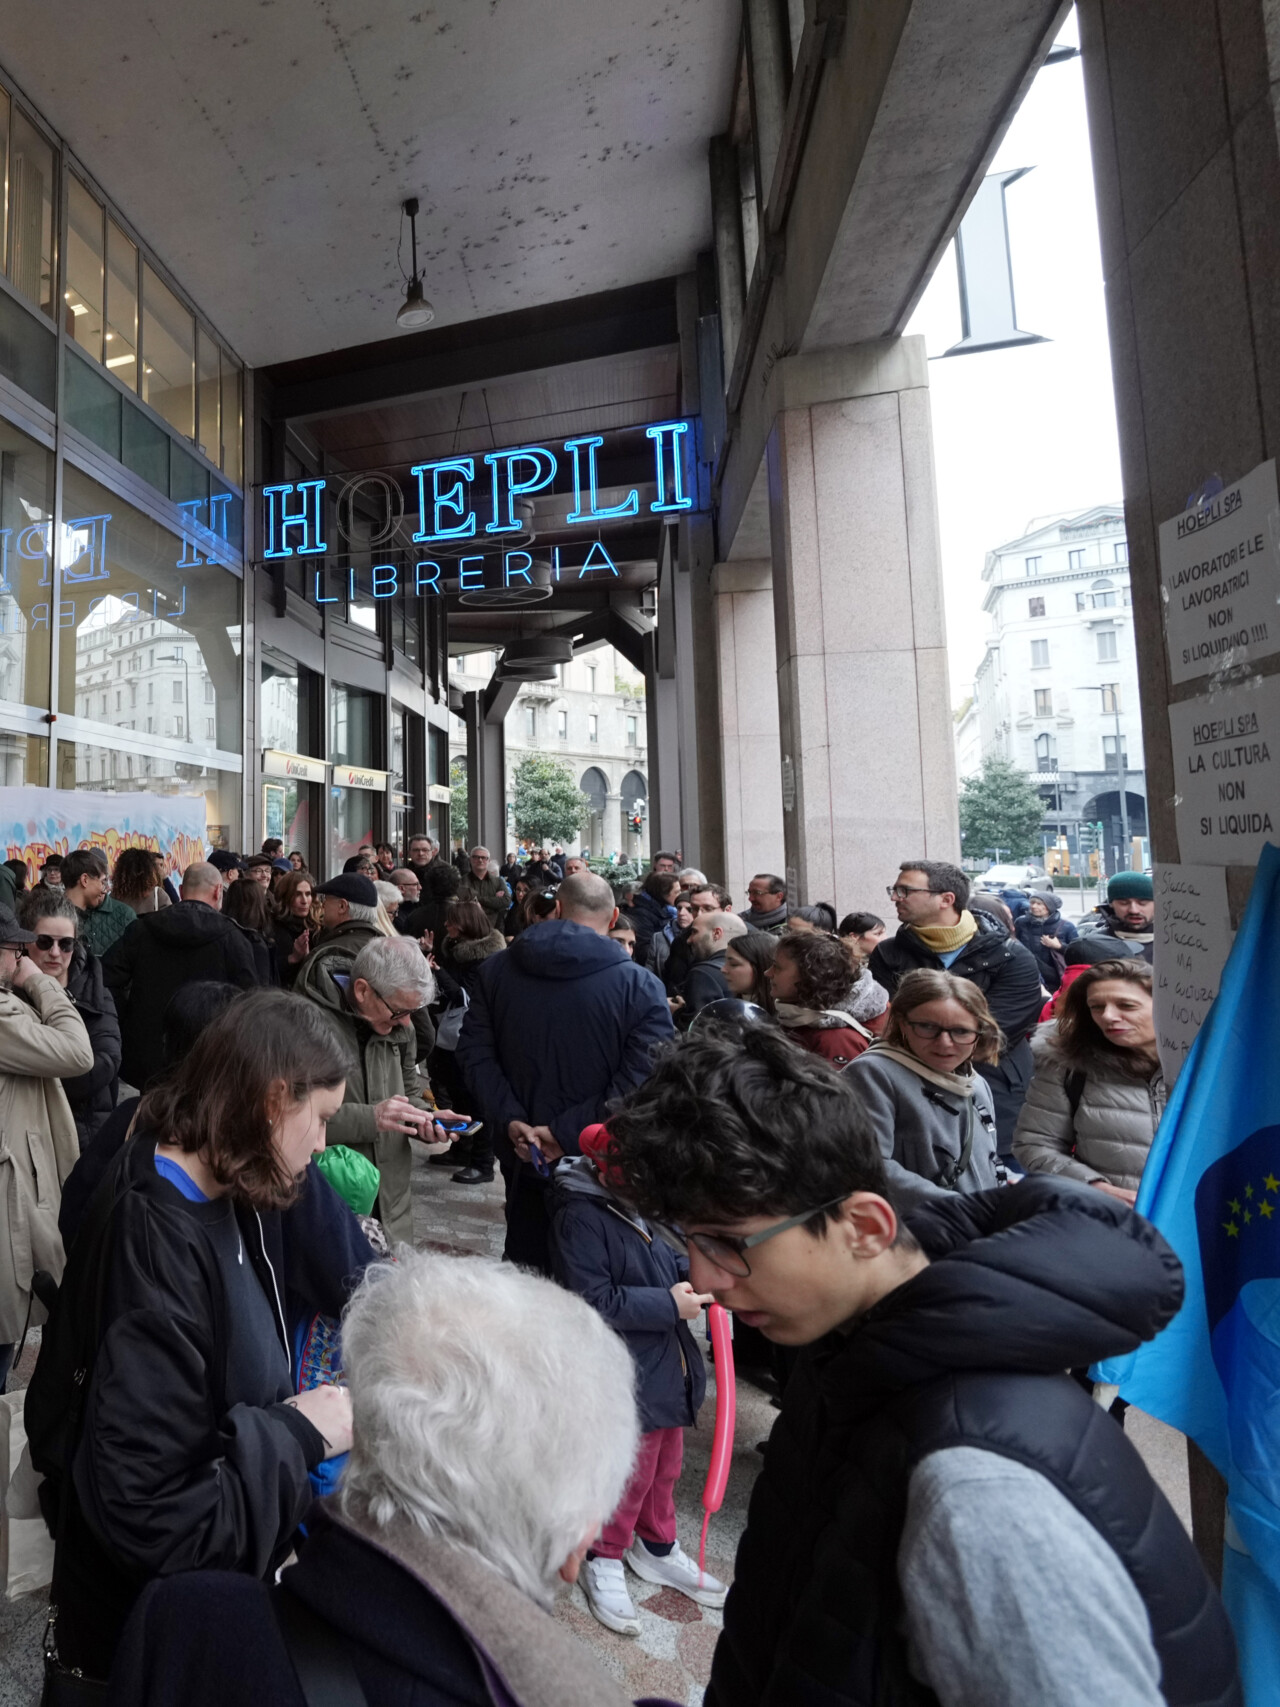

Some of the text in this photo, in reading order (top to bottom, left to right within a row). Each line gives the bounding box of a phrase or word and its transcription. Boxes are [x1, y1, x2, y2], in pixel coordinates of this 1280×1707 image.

[263, 422, 692, 559] HOEPLI
[1177, 488, 1243, 537] HOEPLI SPA
[315, 541, 620, 603] LIBRERIA
[1172, 546, 1238, 590] LAVORATORI
[1238, 542, 1246, 561] E
[1247, 534, 1265, 556] LE
[1181, 569, 1250, 611] LAVORATRICI
[1207, 607, 1234, 629] NON
[1181, 647, 1191, 665] SI
[1191, 629, 1250, 662] LIQUIDANO
[1193, 711, 1259, 742] HOEPLI SPA
[1188, 742, 1271, 774] LA CULTURA
[354, 773, 374, 788] UniCredit
[1218, 780, 1246, 802] NON
[1200, 812, 1273, 836] SI LIQUIDA
[1176, 953, 1193, 972] MA
[1159, 974, 1169, 989] LA
[1170, 1003, 1202, 1027] NON
